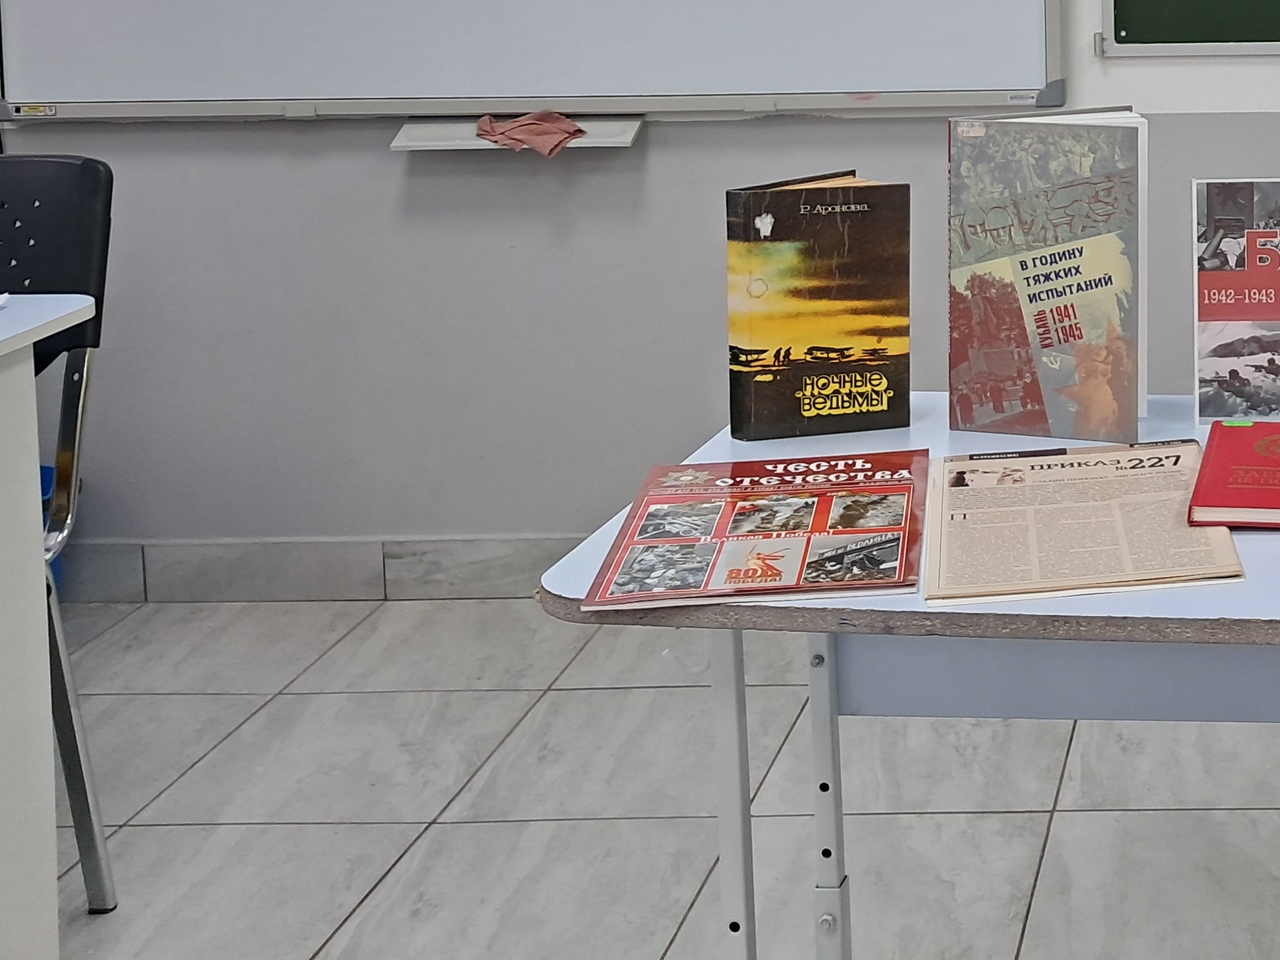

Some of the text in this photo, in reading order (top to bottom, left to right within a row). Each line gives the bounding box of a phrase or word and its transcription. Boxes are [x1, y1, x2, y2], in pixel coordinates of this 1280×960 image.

[812, 203, 870, 215] Аронова
[1019, 246, 1084, 271] В ГОДИНУ
[1023, 265, 1082, 287] ТЯЖКИХ
[1027, 273, 1113, 304] ИСПЫТАНИЙ
[1049, 302, 1078, 325] 1941
[1033, 309, 1054, 349] КУБАНЬ
[1054, 322, 1084, 345] 1945
[764, 459, 873, 474] ЧЕСТЬ
[1029, 458, 1122, 471] ПРИКАЗ
[1127, 454, 1182, 470] 227
[714, 468, 914, 487] ОТЕЧЕСТВА
[700, 529, 833, 543] Великая Победа!
[724, 574, 783, 585] ПОБЕДА!
[727, 568, 759, 579] 80
